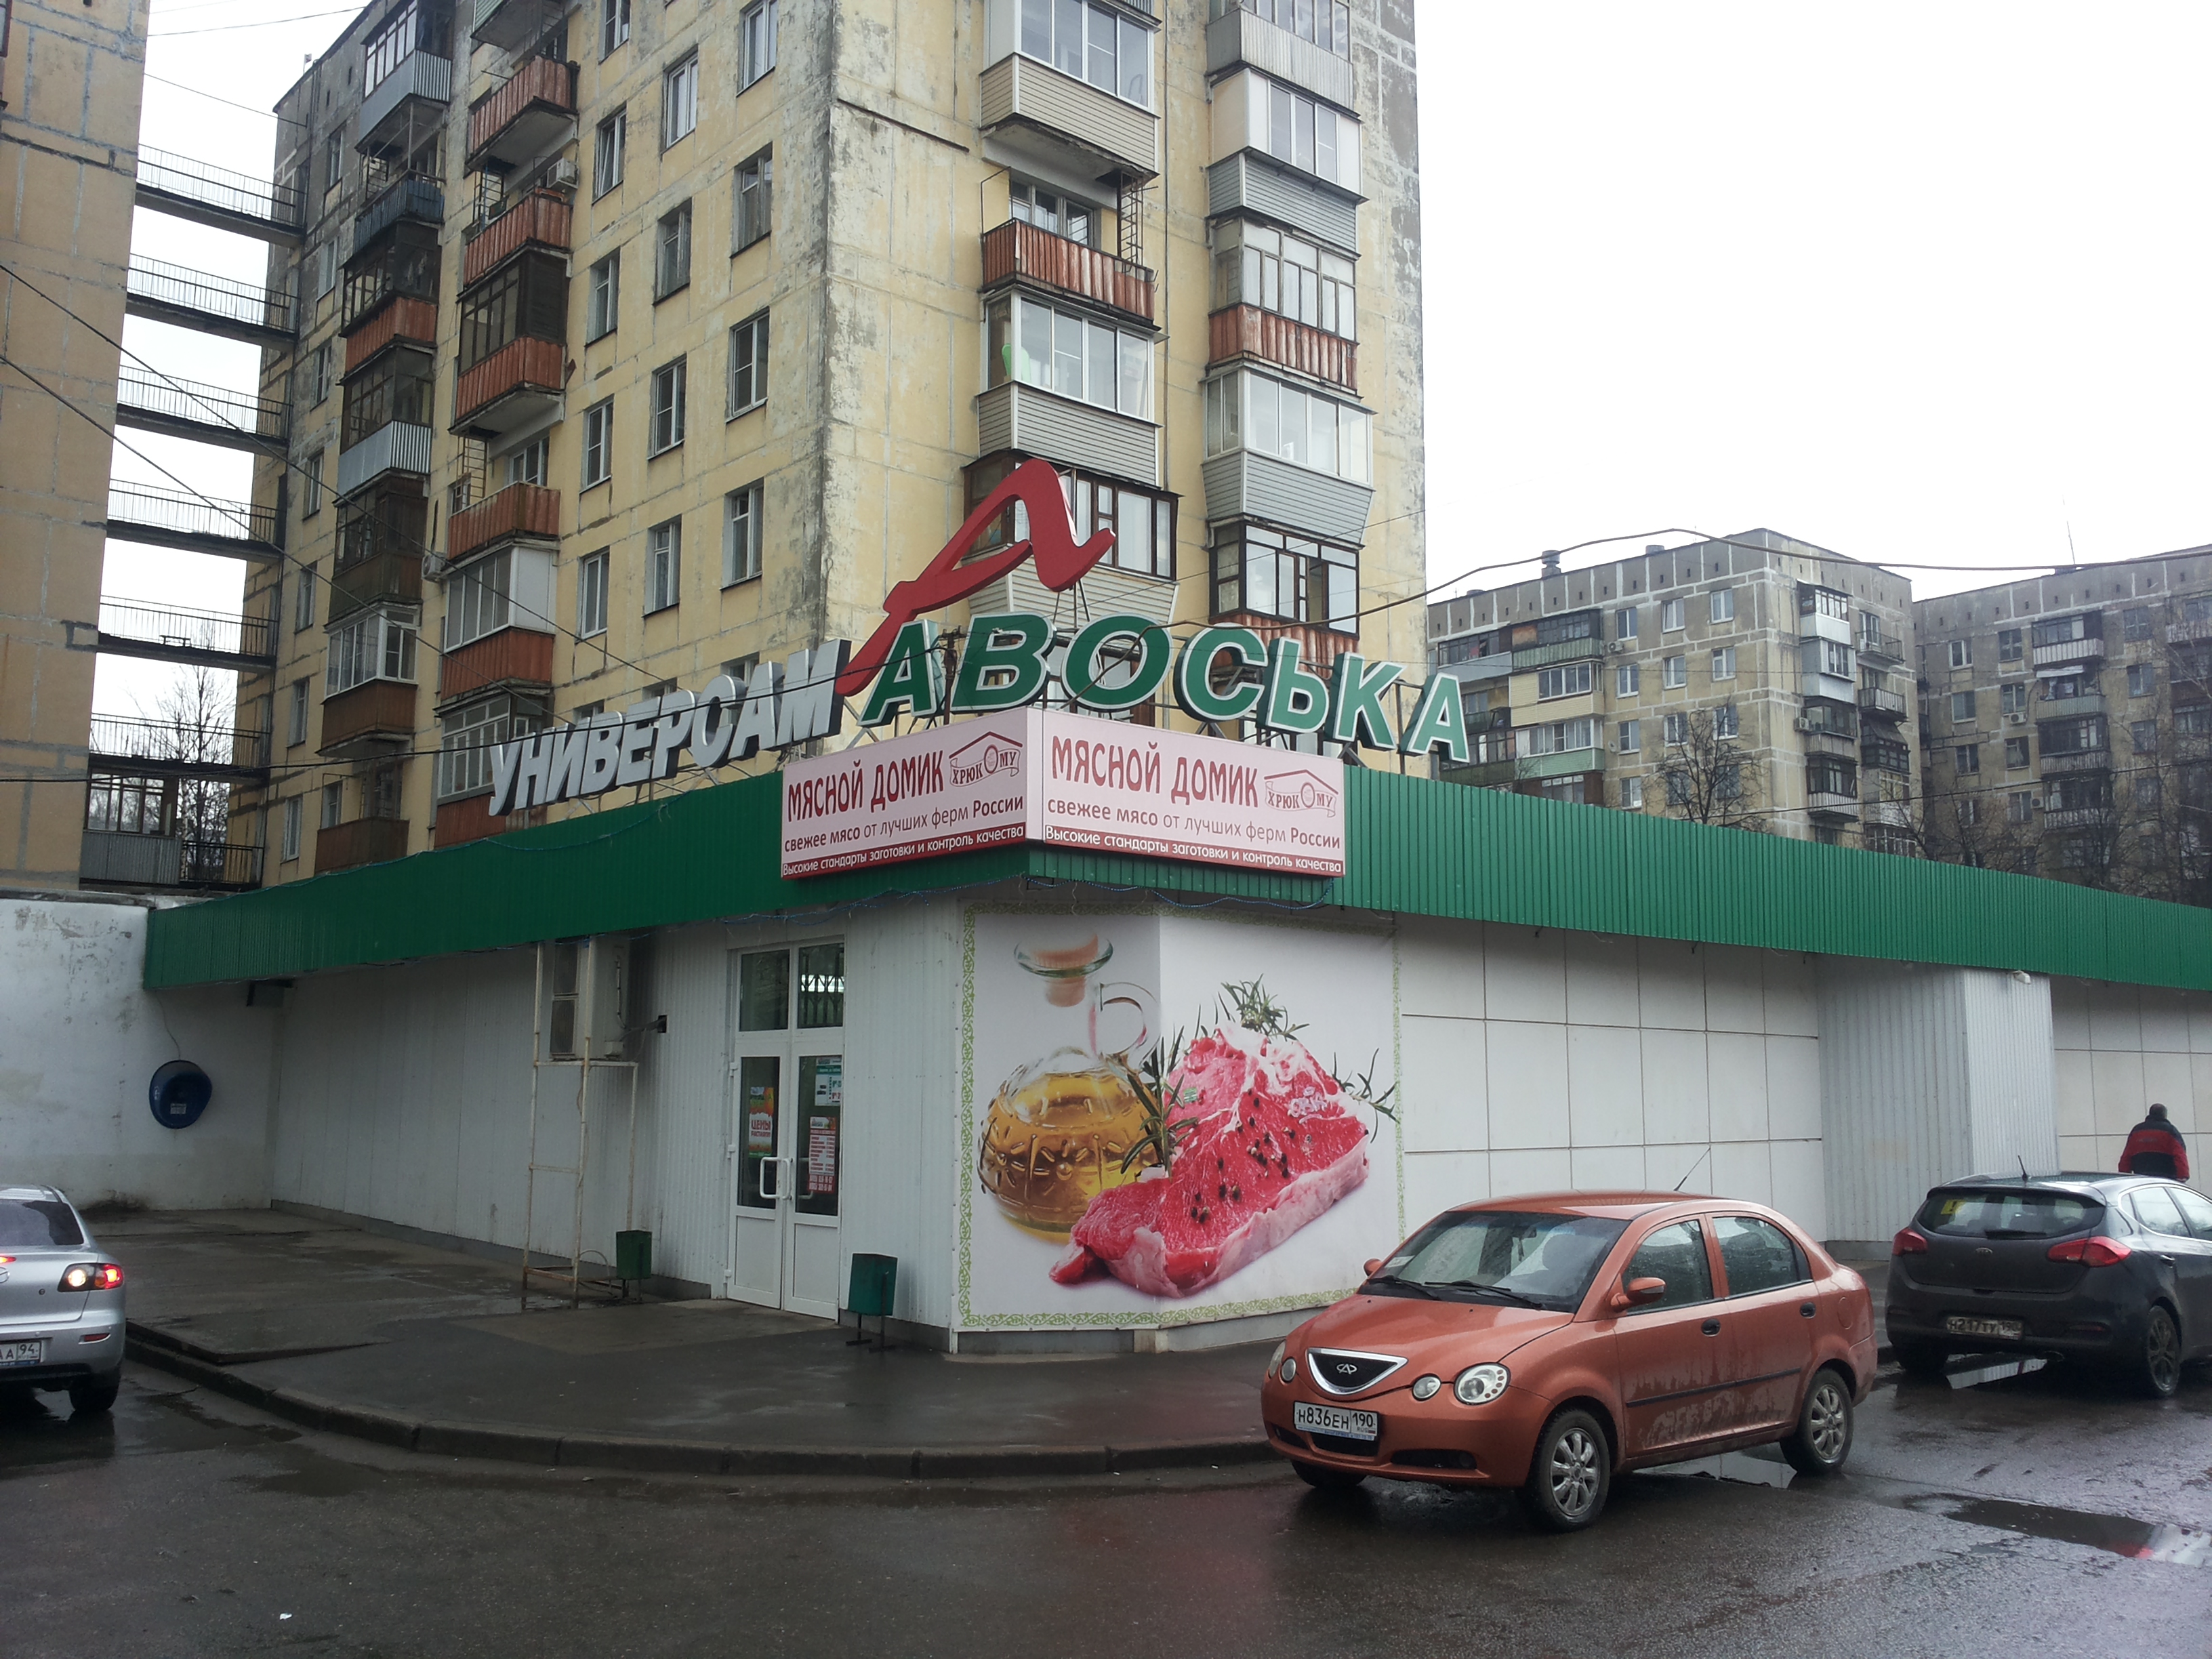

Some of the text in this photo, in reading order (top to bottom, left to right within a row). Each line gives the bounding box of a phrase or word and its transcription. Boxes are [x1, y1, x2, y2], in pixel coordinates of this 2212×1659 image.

[857, 613, 1470, 763] АВОСЬКА
[489, 638, 851, 816] УНИВЕРСАМ
[788, 750, 943, 822] МЯСНОЙ ДОМИК
[1052, 736, 1258, 808] МЯСНОЙ ДОМИК
[783, 824, 1024, 876] Высокие стандарты заготовки и контроль качества
[785, 795, 1023, 853] свежее мясо от лучших ферм России
[1046, 825, 1341, 872] Высокие стандарты заготовки и контроль качества
[1047, 798, 1340, 848] свежее мясо от лучших ферм России
[20, 1343, 35, 1355] 94
[1352, 1412, 1373, 1427] 190
